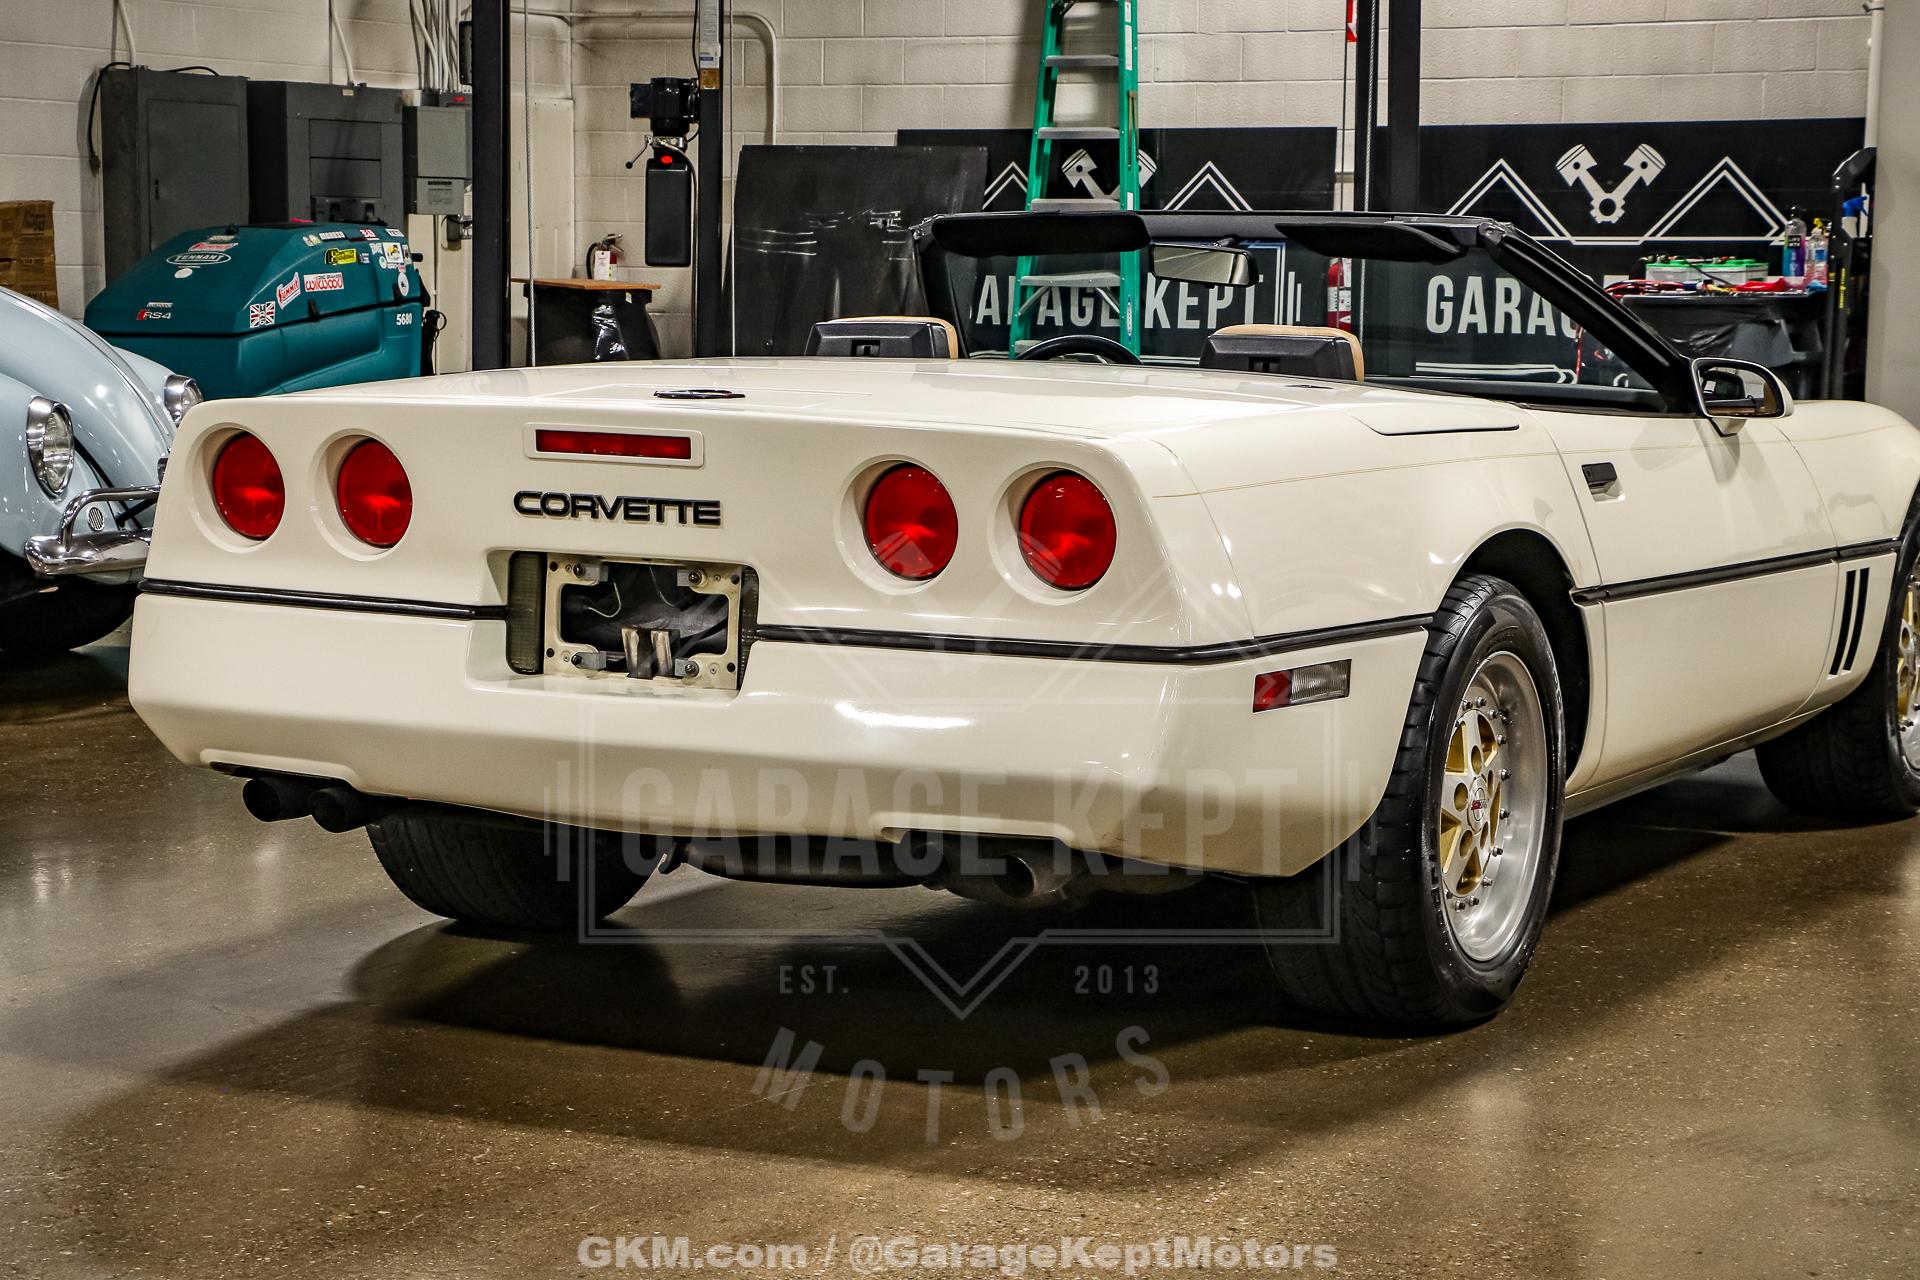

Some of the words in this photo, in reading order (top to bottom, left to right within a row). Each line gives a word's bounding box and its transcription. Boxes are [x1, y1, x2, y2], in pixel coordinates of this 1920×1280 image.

[174, 254, 224, 262] TENNANT
[969, 275, 1120, 328] AAGE
[1144, 272, 1264, 329] KEPT
[142, 311, 172, 320] RS4
[396, 312, 413, 326] 5680
[514, 490, 721, 526] CORVETTE
